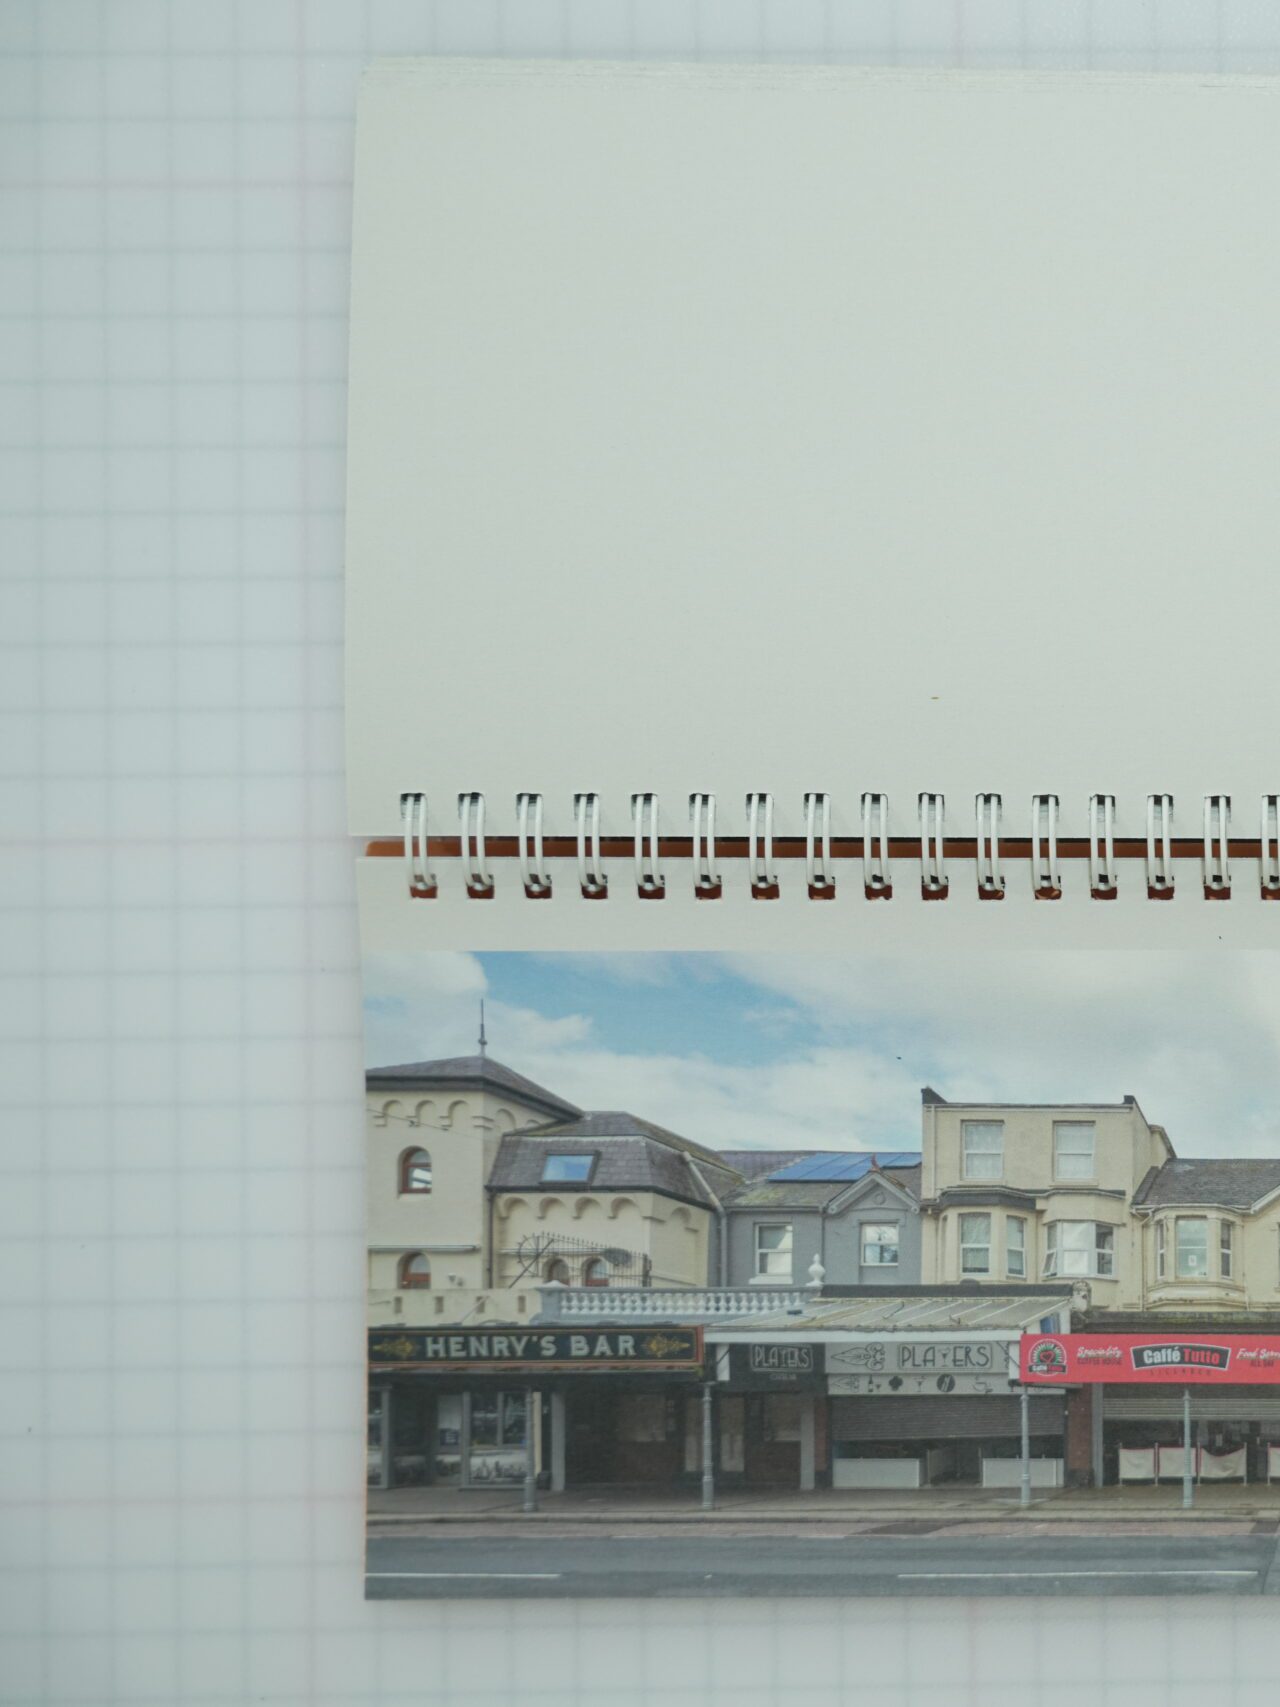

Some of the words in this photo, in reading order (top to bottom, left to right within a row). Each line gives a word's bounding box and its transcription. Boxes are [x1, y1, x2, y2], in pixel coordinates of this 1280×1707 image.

[426, 1335, 557, 1358] HENRY'S
[570, 1335, 636, 1357] BAR
[901, 1345, 990, 1367] PLAYERS
[1143, 1346, 1181, 1364] Caffé
[1183, 1348, 1220, 1365] Tutto
